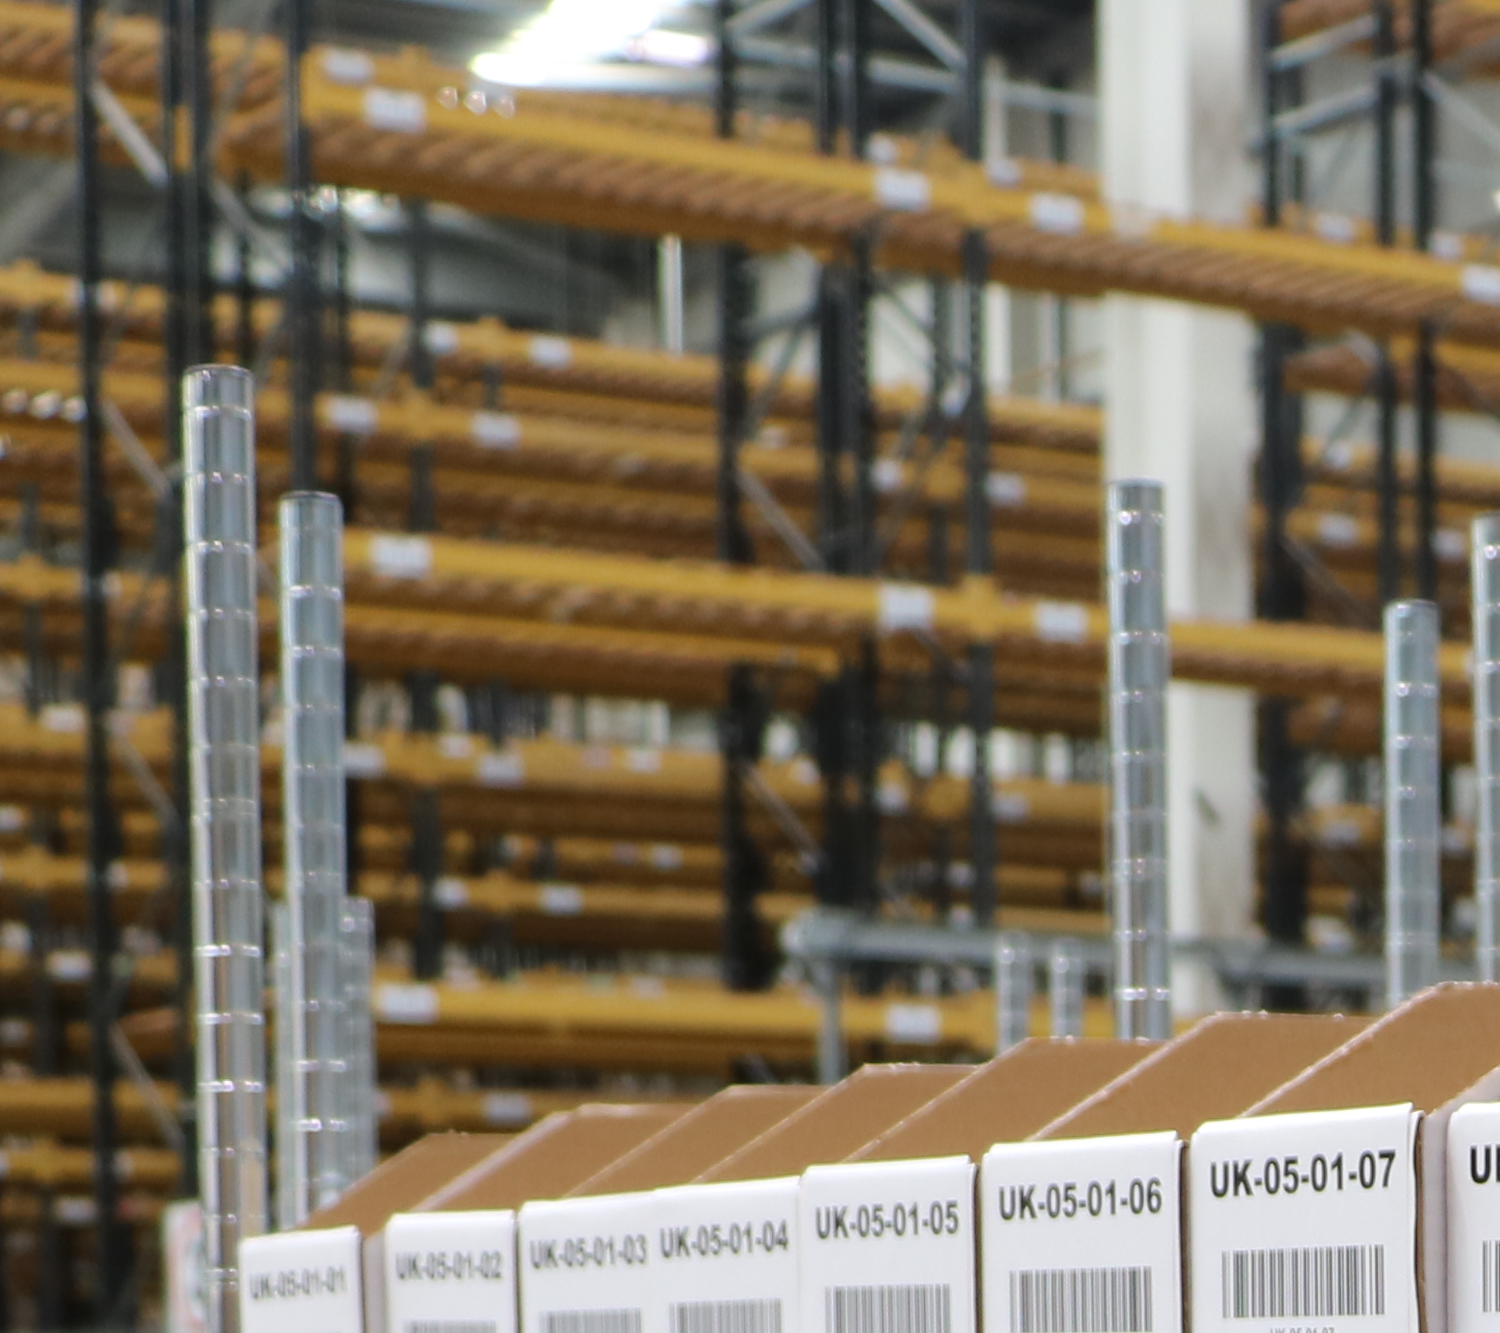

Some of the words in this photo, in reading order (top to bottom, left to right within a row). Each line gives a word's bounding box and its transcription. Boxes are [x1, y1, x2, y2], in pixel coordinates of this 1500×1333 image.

[1210, 1150, 1396, 1199] UK-05-01-07
[999, 1177, 1162, 1221] UK-05-01-06
[660, 1220, 789, 1260] UK-05-01-04
[815, 1200, 959, 1241] UK-05-01-05
[530, 1234, 647, 1271] UK-05-01-03
